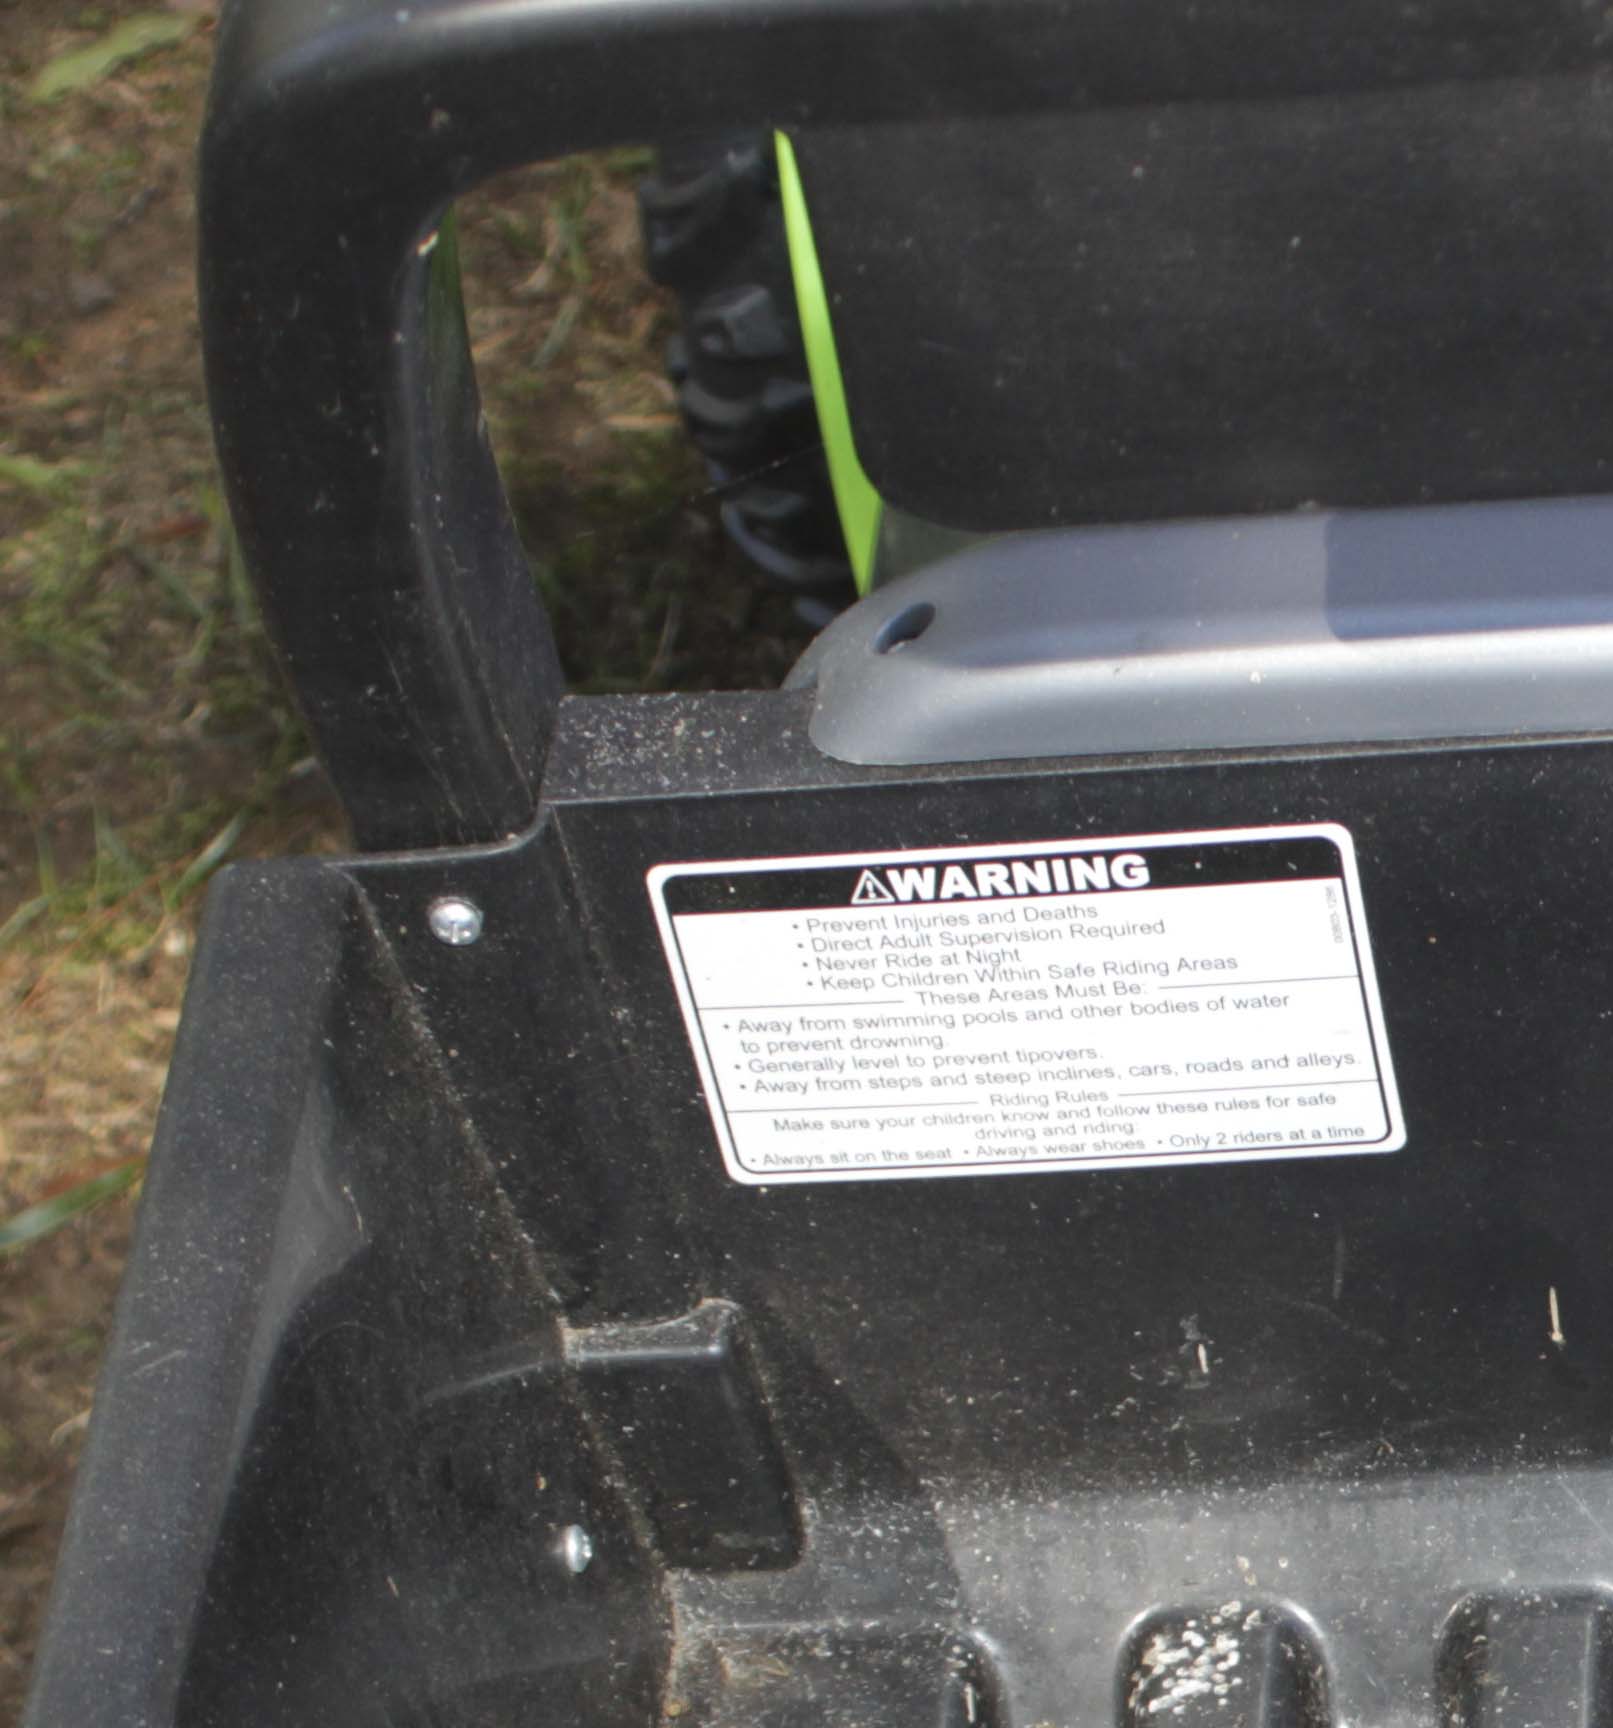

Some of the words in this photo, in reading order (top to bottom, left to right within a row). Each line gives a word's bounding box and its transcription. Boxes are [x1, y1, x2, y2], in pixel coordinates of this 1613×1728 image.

[887, 854, 1150, 901] WARNING
[806, 914, 887, 932] Prevent
[894, 910, 970, 931] Injuries
[977, 907, 1016, 923] and
[1023, 903, 1100, 921] Deaths
[811, 935, 872, 953] Direct
[879, 932, 932, 949] Adult
[939, 924, 1062, 949] Supervision
[1069, 919, 1166, 942] Required
[816, 953, 877, 970] Never
[884, 951, 933, 967] Ride
[939, 950, 958, 964] at
[965, 947, 1023, 967] Night
[821, 973, 875, 993] Keep
[881, 968, 969, 987] Children
[975, 964, 1040, 982] Within
[1048, 961, 1096, 978] Safe
[1103, 957, 1169, 978] Riding
[1176, 954, 1239, 971] Areas
[917, 988, 980, 1005] These
[988, 984, 1048, 1001] Areas
[1055, 982, 1106, 998] Must
[738, 1017, 792, 1037] Away
[799, 1014, 846, 1031] from
[852, 1009, 955, 1032] swimming
[962, 1006, 1018, 1026] pools
[1024, 1004, 1063, 1020] and
[1069, 1001, 1122, 1017] other
[1130, 997, 1200, 1014] bodies
[1206, 996, 1225, 1011] of
[1232, 993, 1291, 1009] water
[740, 1038, 761, 1053] to
[766, 1035, 843, 1055] prevent
[747, 1055, 845, 1077] Generally
[852, 1053, 900, 1069] level
[906, 1052, 926, 1067] to
[932, 1048, 1009, 1069] prevent
[1015, 1044, 1104, 1065] tipovers.
[753, 1077, 808, 1097] Away
[815, 1075, 862, 1091] from
[867, 1072, 923, 1092] steps
[929, 1070, 967, 1085] and
[974, 1066, 1031, 1087] steep
[1037, 1062, 1121, 1084] inclines,
[1128, 1064, 1178, 1079] cars,
[1185, 1056, 1244, 1073] roads
[1250, 1054, 1290, 1070] and
[1296, 1050, 1361, 1071] alleys.
[772, 1116, 824, 1133] Make
[829, 1118, 870, 1130] sure
[875, 1116, 915, 1131] your
[921, 1108, 995, 1125] children
[1000, 1105, 1049, 1121] know
[1056, 1103, 1091, 1119] and
[1096, 1100, 1150, 1117] follow
[1156, 1097, 1208, 1114] these
[1214, 1094, 1261, 1111] rules
[1265, 1093, 1290, 1108] for
[1296, 1091, 1337, 1107] safe
[989, 1089, 1049, 1109] Riding
[1054, 1087, 1111, 1103] Rules
[762, 1149, 824, 1169] Always
[829, 1148, 849, 1163] sit
[854, 1151, 877, 1162] on
[881, 1146, 910, 1161] the
[914, 1144, 953, 1160] seat
[975, 1140, 1038, 1161] Always
[1043, 1142, 1086, 1154] wear
[1091, 1135, 1147, 1151] shoes
[1169, 1131, 1210, 1150] Only
[1216, 1130, 1227, 1144] 2
[1232, 1126, 1283, 1143] riders
[1288, 1125, 1305, 1140] at
[1310, 1128, 1322, 1139] a
[1326, 1122, 1367, 1138] time
[973, 1123, 1036, 1143] driving
[1042, 1121, 1077, 1136] and
